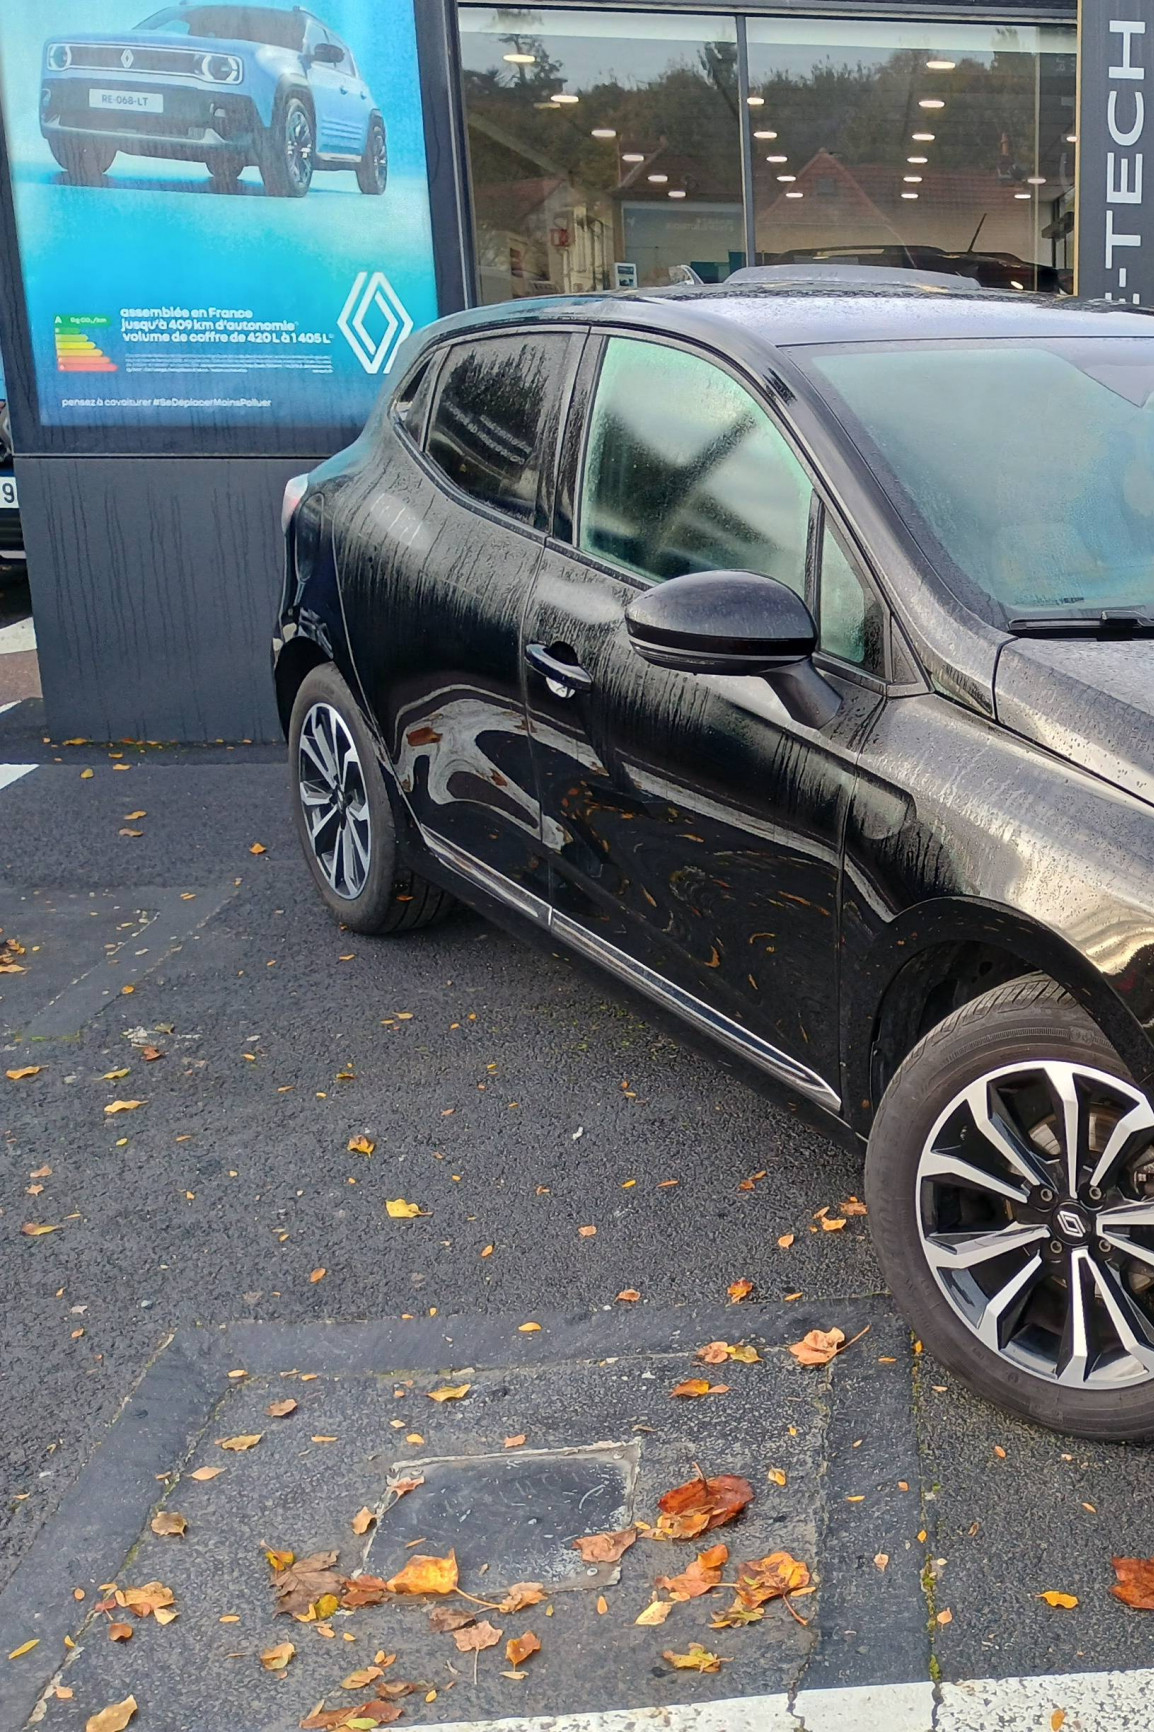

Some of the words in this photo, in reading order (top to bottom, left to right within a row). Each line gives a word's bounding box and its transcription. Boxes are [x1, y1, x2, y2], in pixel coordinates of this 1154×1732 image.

[101, 94, 149, 106] RE-068-LT
[1105, 20, 1146, 304] -TECH
[120, 306, 190, 318] assemblée
[191, 308, 208, 318] en
[208, 307, 253, 319] France
[55, 316, 62, 324] A
[121, 318, 168, 332] jusqu'à
[168, 320, 193, 331] 409
[193, 320, 214, 331] km
[215, 321, 296, 332] d'autonomie
[122, 331, 170, 342] volume
[171, 331, 188, 342] de
[189, 331, 229, 343] coffre
[229, 332, 246, 343] de
[247, 333, 272, 344] 420
[273, 333, 281, 344] L
[281, 332, 291, 343] à
[62, 399, 96, 408] pensez
[97, 397, 104, 407] à
[105, 398, 152, 407] covoiturer
